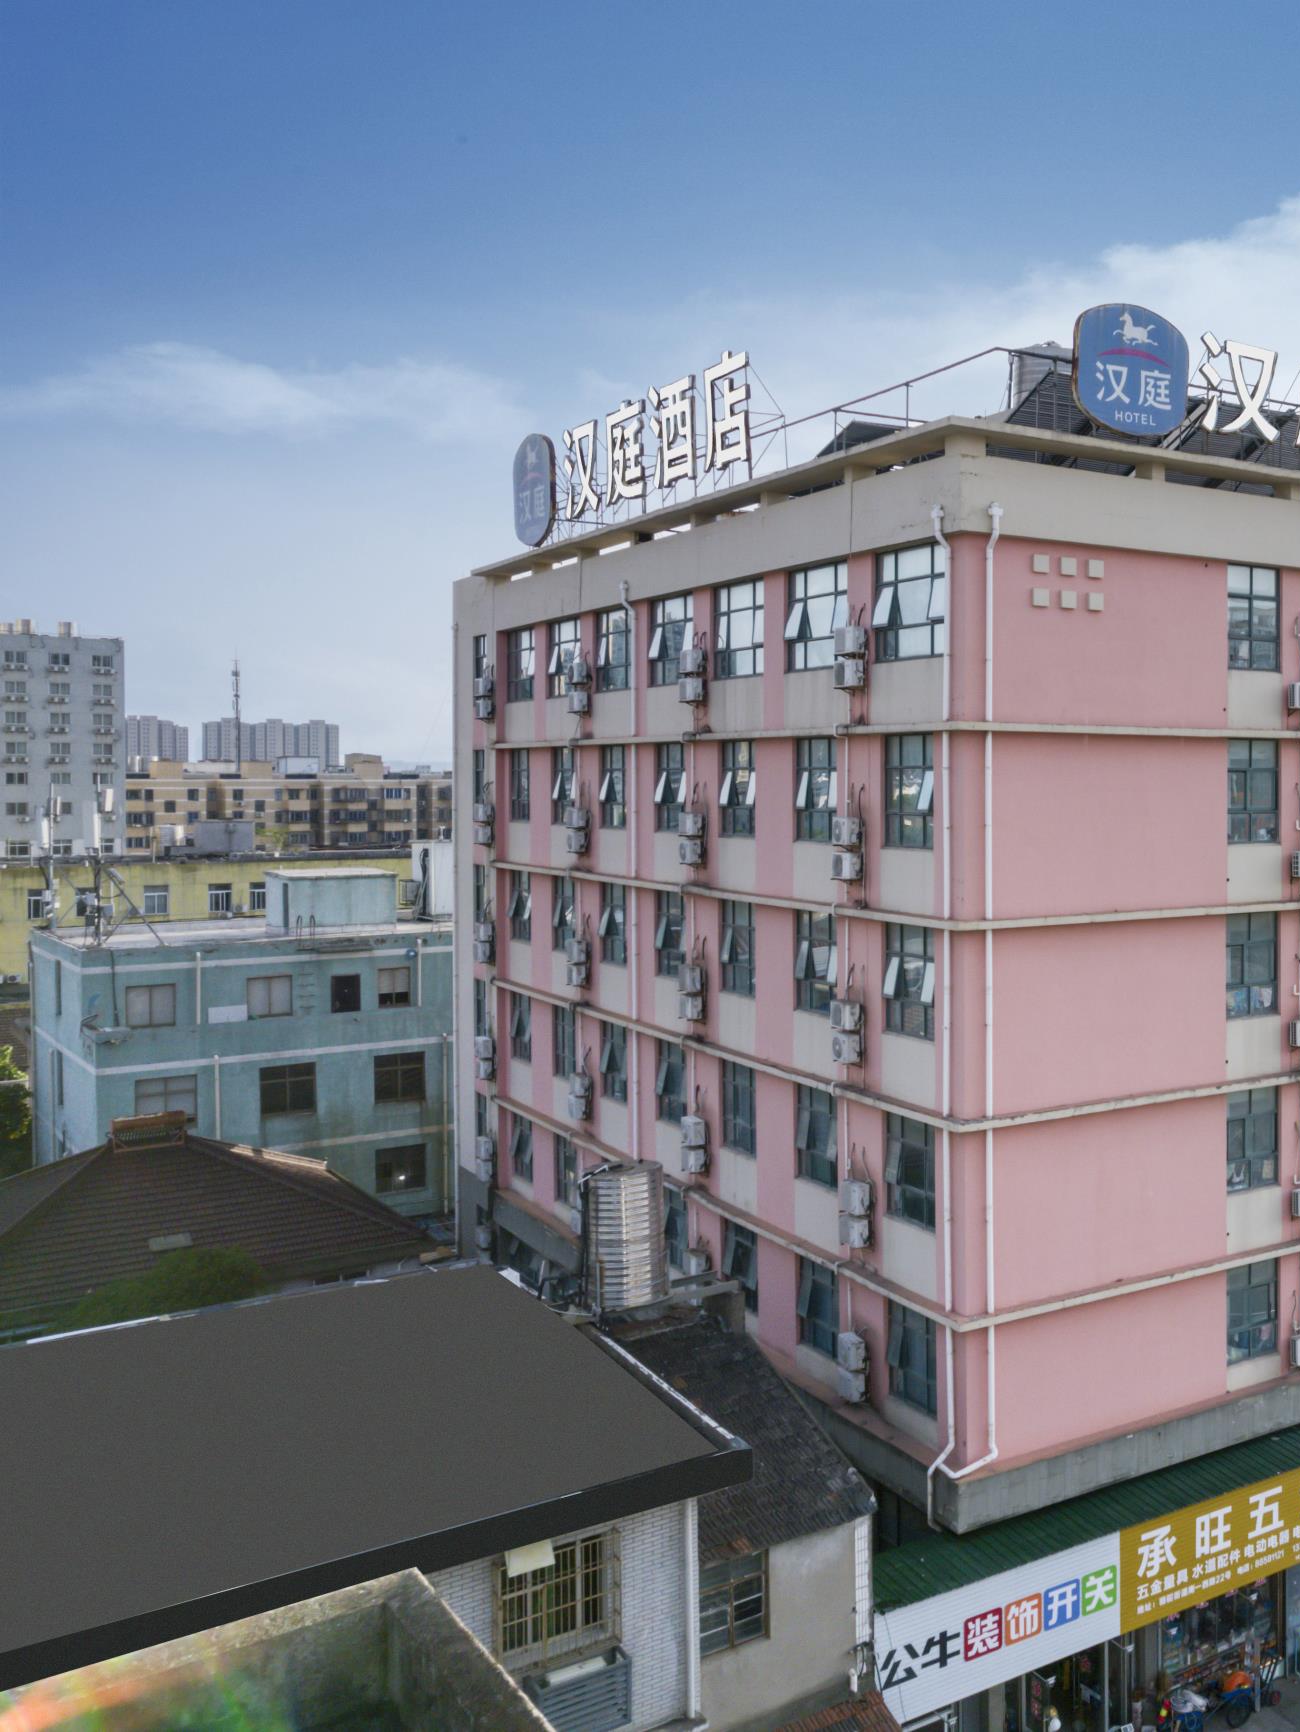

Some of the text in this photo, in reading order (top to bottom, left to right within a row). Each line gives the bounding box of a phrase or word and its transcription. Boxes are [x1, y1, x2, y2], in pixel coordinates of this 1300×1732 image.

[1095, 360, 1172, 411] 汉庭
[563, 350, 752, 520] 汉庭酒店
[1115, 409, 1156, 427] HOTEL
[519, 484, 546, 524] 汉庭
[881, 1567, 1116, 1690] 公牛装饰开关
